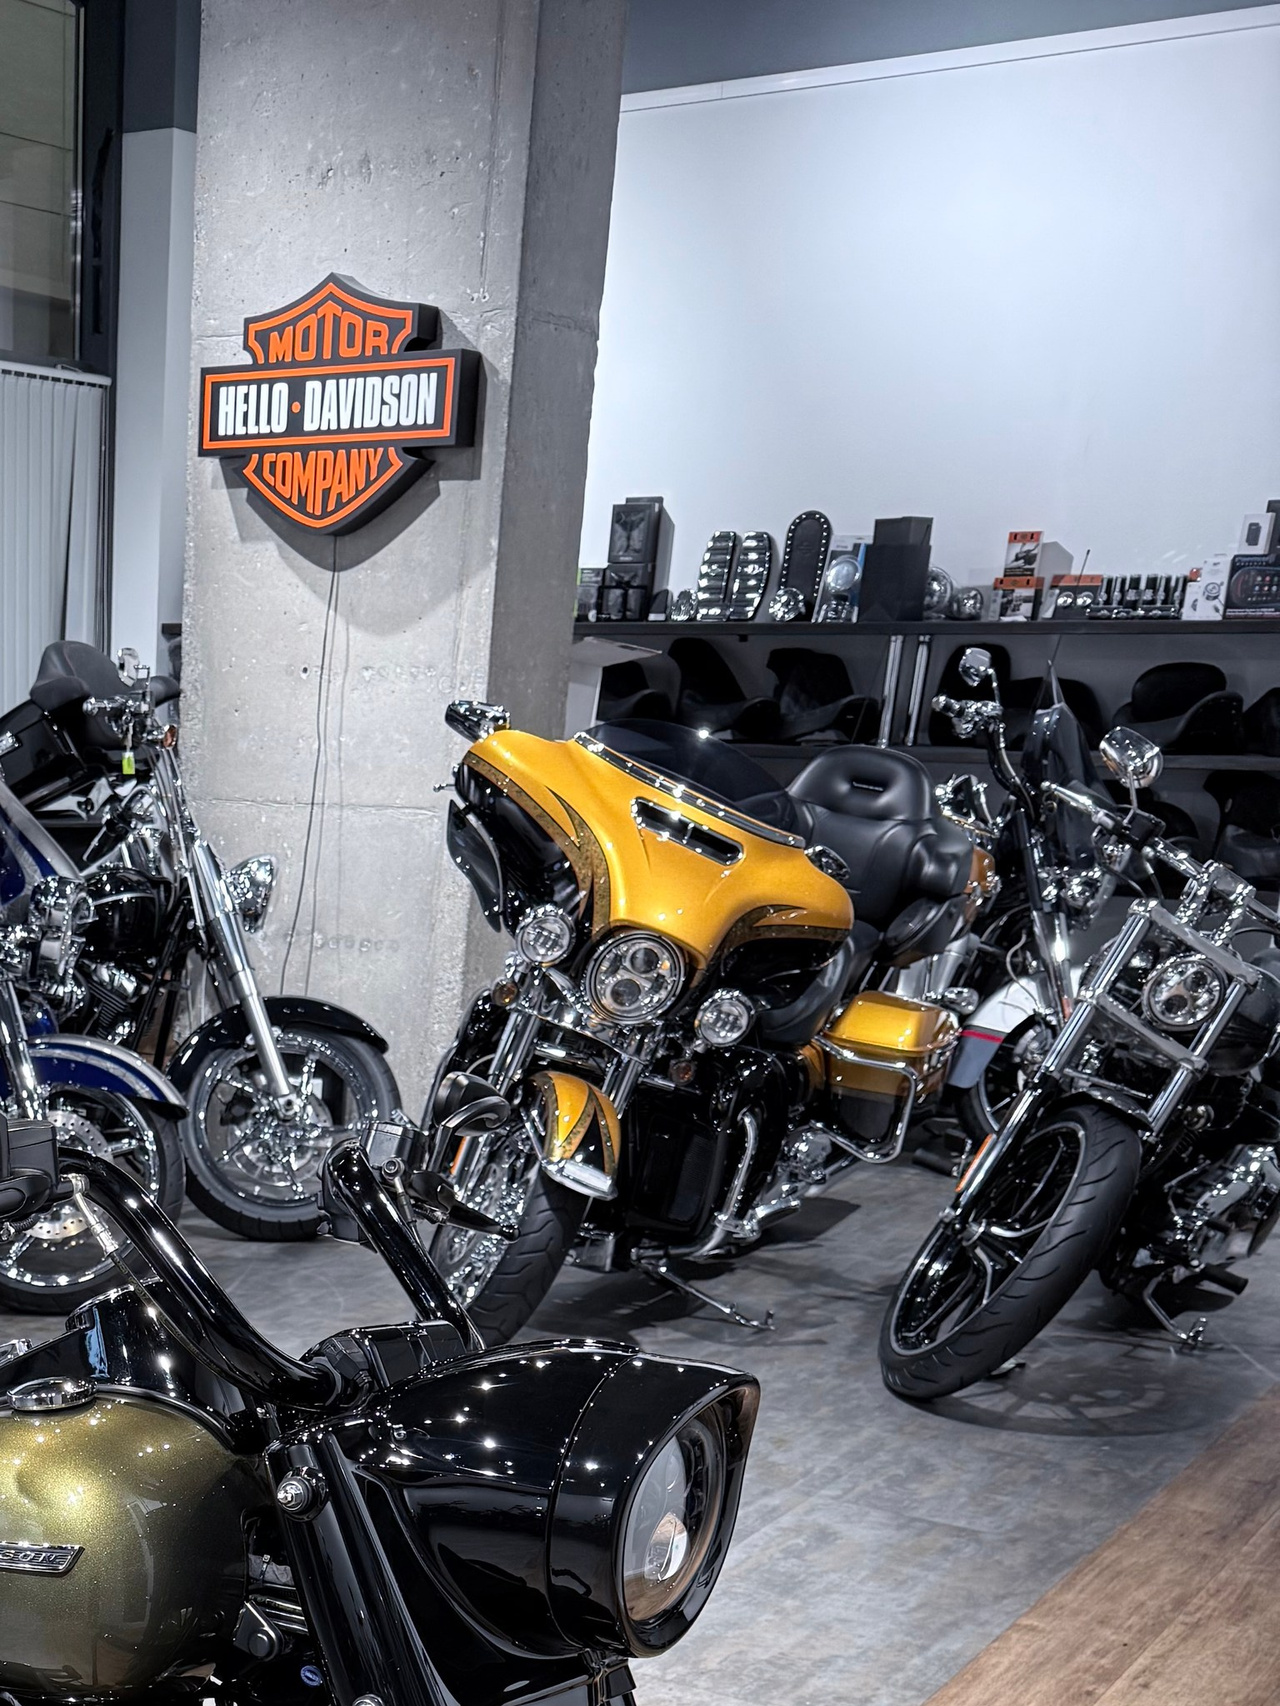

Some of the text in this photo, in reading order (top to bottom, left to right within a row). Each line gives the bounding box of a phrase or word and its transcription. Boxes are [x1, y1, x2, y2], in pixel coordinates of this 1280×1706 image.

[268, 300, 389, 364] MOTOR
[217, 372, 438, 436] HELLO DAVIDSON
[261, 446, 385, 516] COMPANY
